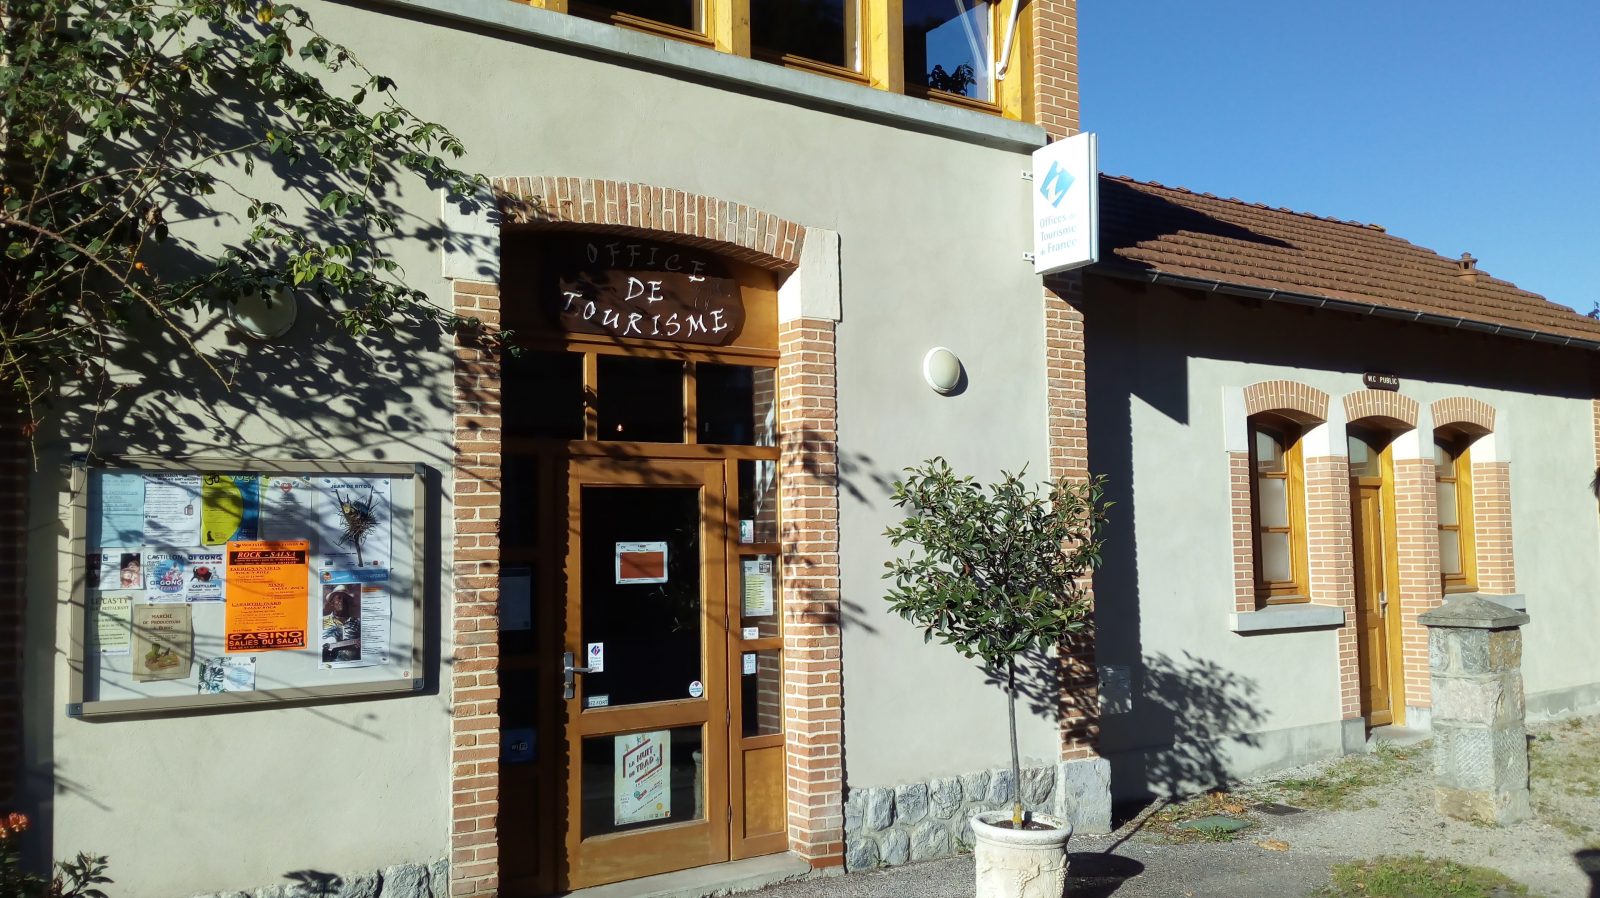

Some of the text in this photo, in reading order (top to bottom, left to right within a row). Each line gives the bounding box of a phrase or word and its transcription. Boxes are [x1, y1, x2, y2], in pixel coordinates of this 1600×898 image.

[1040, 215, 1066, 228] Offices
[1040, 226, 1077, 241] Tourisme
[1048, 239, 1077, 253] France
[587, 243, 706, 282] OFFICE
[624, 276, 664, 304] DE
[563, 291, 728, 338] TOURISME
[146, 553, 183, 561] CASTILLON
[198, 553, 223, 561] GONG
[228, 639, 259, 647] SALIES
[276, 637, 303, 645] SALAT
[229, 631, 303, 641] CASINO
[628, 745, 654, 768] LA NUIT
